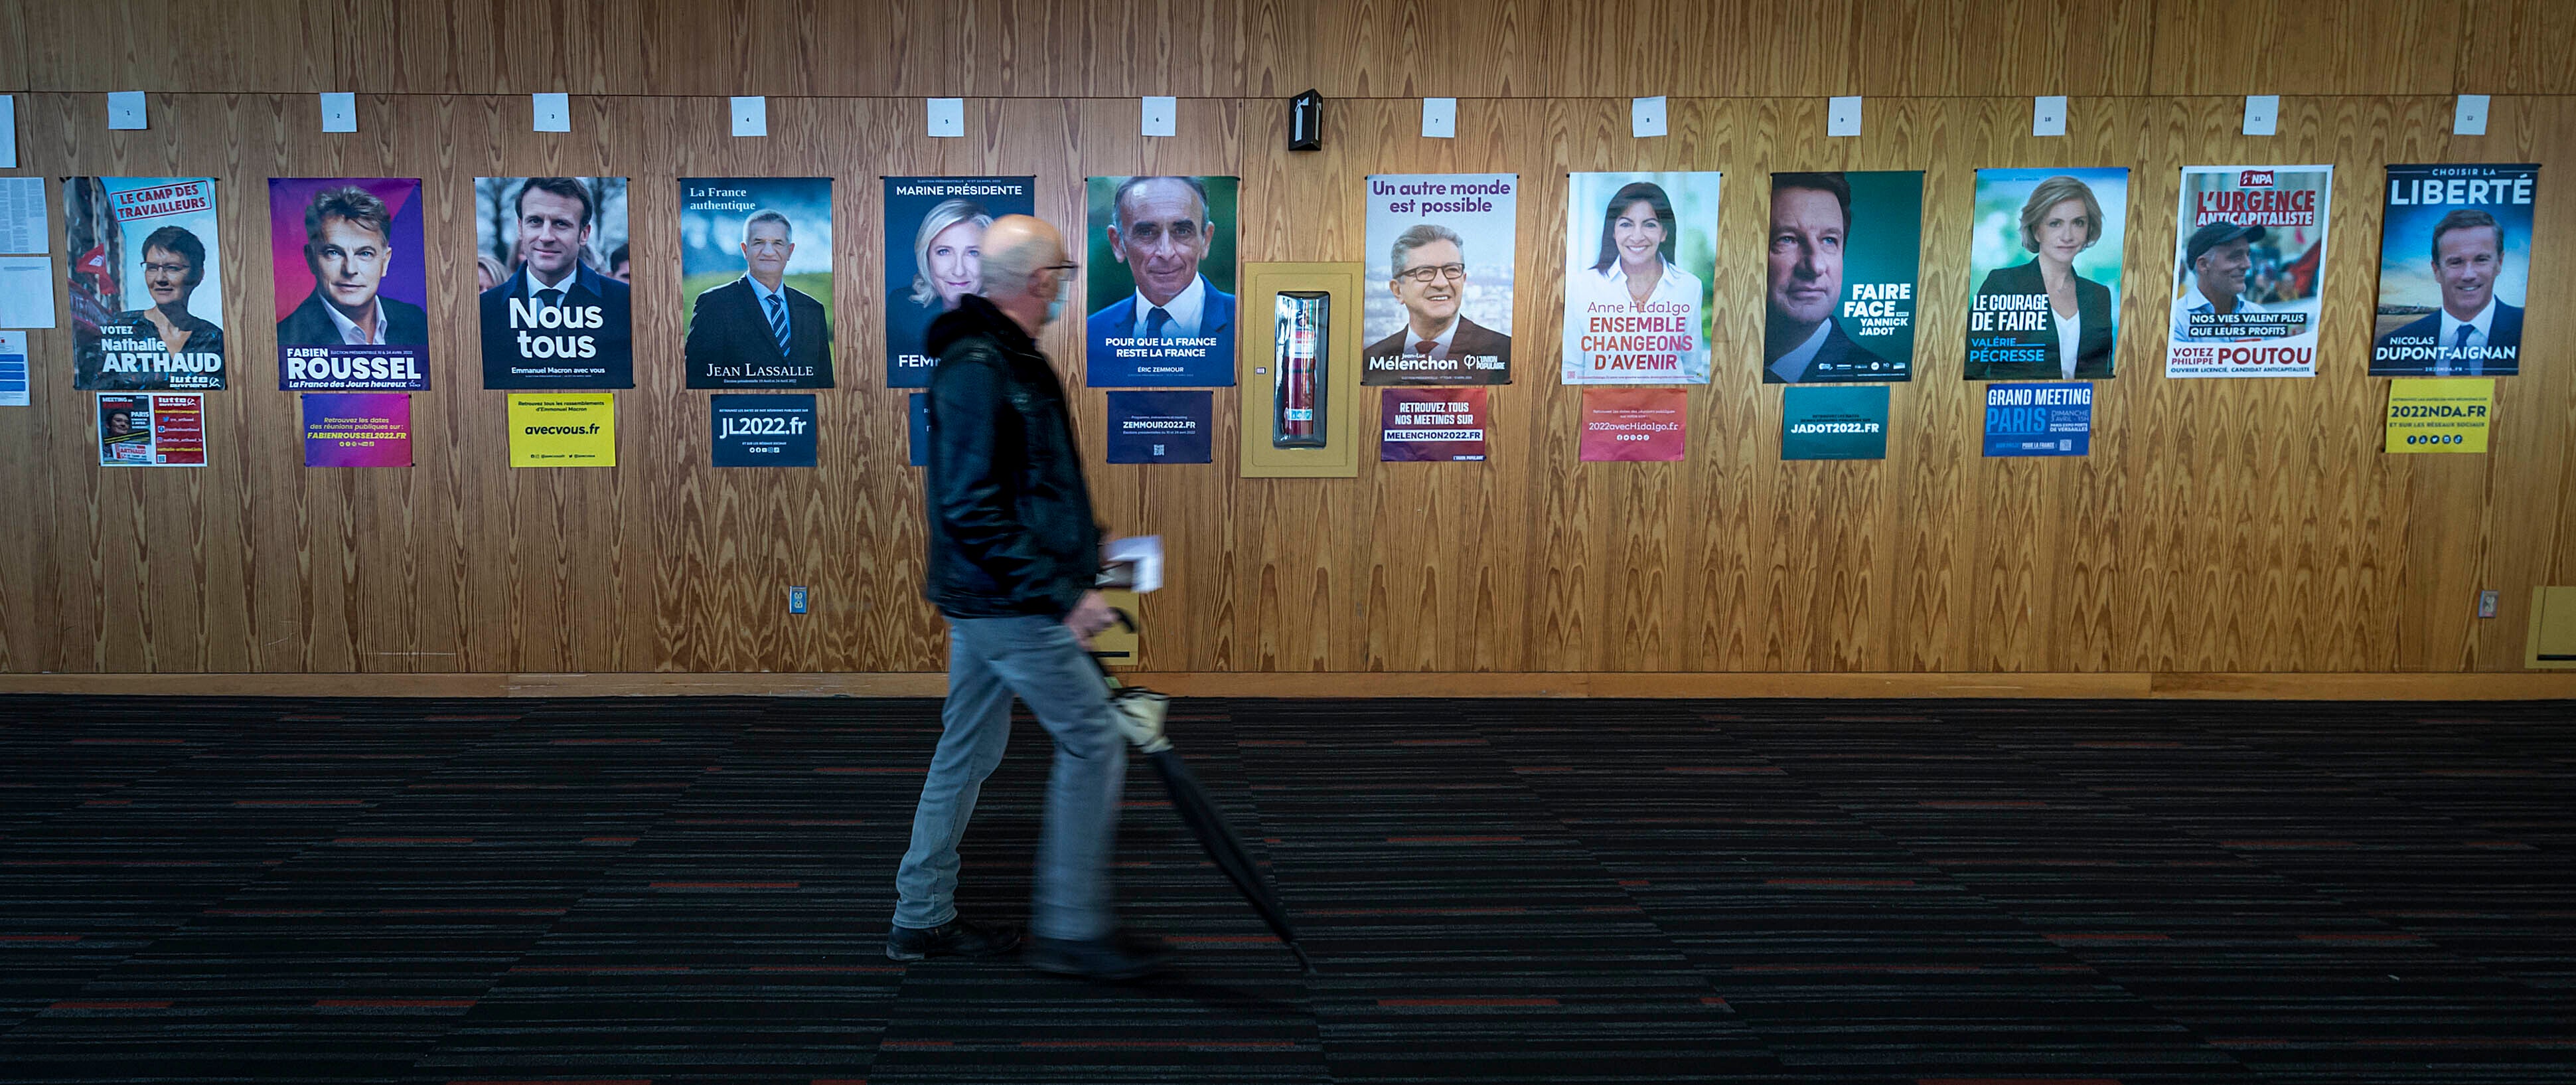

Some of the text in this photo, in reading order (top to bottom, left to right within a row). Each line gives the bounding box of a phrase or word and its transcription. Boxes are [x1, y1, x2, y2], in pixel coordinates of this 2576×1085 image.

[2251, 174, 2273, 184] NPA
[690, 187, 747, 197] La France
[896, 183, 1022, 195] MARINE PRÉSIDENTE
[1373, 179, 1511, 195] Un autre monde
[2390, 173, 2533, 205] LIBERTÉ
[119, 185, 198, 205] LE CAMP DES
[2198, 191, 2315, 211] L'URGENCE
[117, 197, 206, 218] TRAVAILLEURS
[690, 201, 756, 212] authentique
[1389, 197, 1492, 216] est possible
[2197, 211, 2312, 226] ANTICAPITALISTE
[1853, 283, 1911, 300] FAIRE
[1587, 301, 1691, 316] Anne Hidalgo
[1843, 301, 1896, 317] FACE
[1973, 293, 2049, 311] LE COURAGE
[509, 297, 604, 329] Nous
[2191, 315, 2215, 323] NOS
[2242, 314, 2279, 323] VALENT
[2281, 313, 2305, 322] PLUS
[1590, 317, 1686, 333] ENSEMBLE
[1860, 318, 1908, 327] YANNICK
[1971, 311, 2048, 331] DE FAIRE
[1859, 327, 1895, 336] JADOT
[2190, 327, 2286, 336] QUE LEURS PROFITS
[101, 337, 166, 351] Nathalie
[517, 330, 597, 359] tous
[1105, 337, 1134, 346] POUR
[1136, 337, 1159, 346] QUE
[1175, 337, 1217, 346] FRANCE
[1580, 335, 1693, 351] CHANGEONS
[1971, 335, 2016, 347] VALÉRIE
[2389, 337, 2435, 345] NICOLAS
[287, 348, 329, 357] FABIEN
[1116, 349, 1205, 357] RESTE LA FRANCE
[1969, 347, 2045, 362] PÉCRESSE
[2173, 348, 2214, 357] VOTEZ
[2218, 347, 2312, 365] POUTOU
[2376, 346, 2516, 361] DUPONT-AIGNAN
[102, 353, 222, 373] ARTHAUD
[287, 357, 421, 380] ROUSSEL
[706, 363, 814, 376] JEAN LASSALLE
[1369, 355, 1458, 371] Mélenchon
[1594, 355, 1677, 371] D'AVENIR
[1988, 388, 2091, 406] GRAND MEETING
[1400, 402, 1469, 413] RETROUVEZ TOUS
[2390, 406, 2486, 418] 2022NDA.FR
[1395, 414, 1474, 425] NOS MEETINGS SUR
[1589, 422, 1679, 432] 2022avecHidalgo.fr
[1986, 407, 2046, 432] PARIS
[525, 423, 600, 435] avecvous.fr
[719, 416, 807, 440] JL2022.fr
[1791, 423, 1879, 434] JADOT2022.FR
